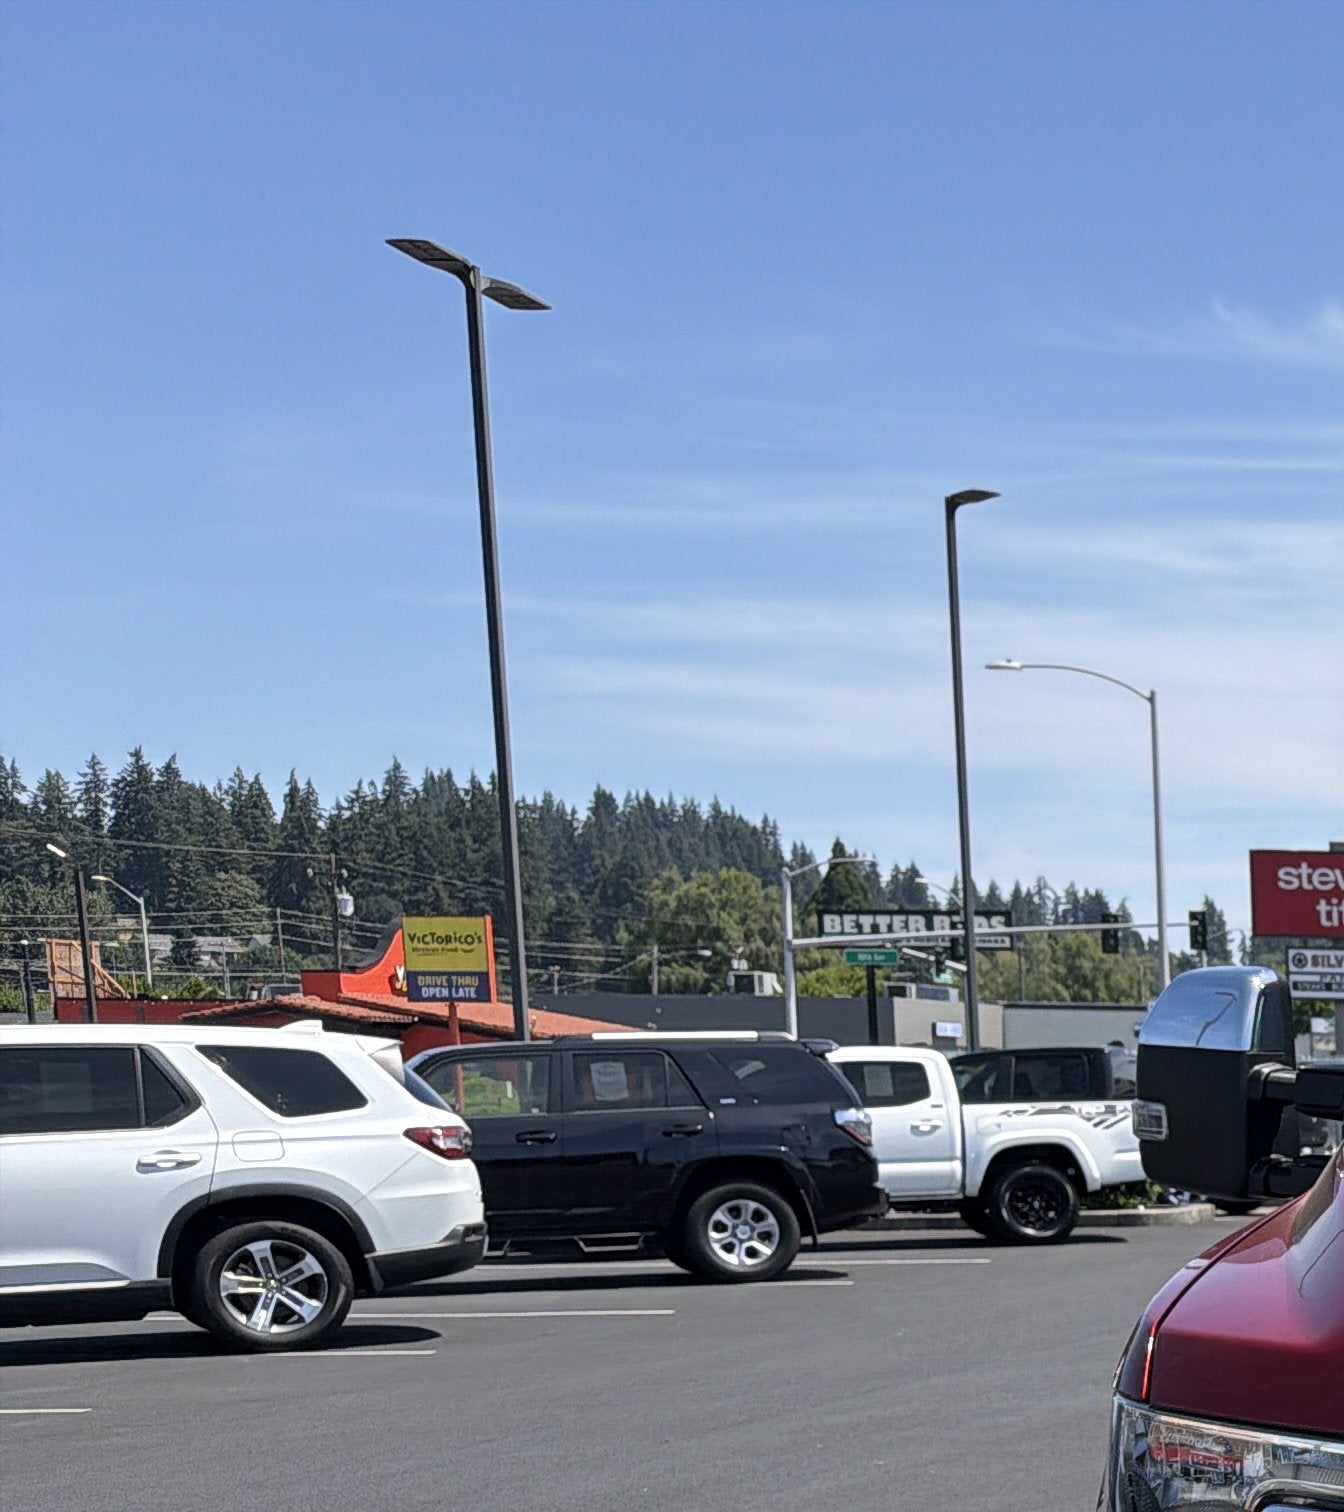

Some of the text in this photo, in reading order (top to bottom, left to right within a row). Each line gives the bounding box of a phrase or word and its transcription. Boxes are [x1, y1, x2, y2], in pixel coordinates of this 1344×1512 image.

[823, 913, 926, 933] BETTER
[417, 975, 449, 987] DRIVE
[450, 975, 479, 987] THRU
[421, 986, 478, 998] OPEN LATE
